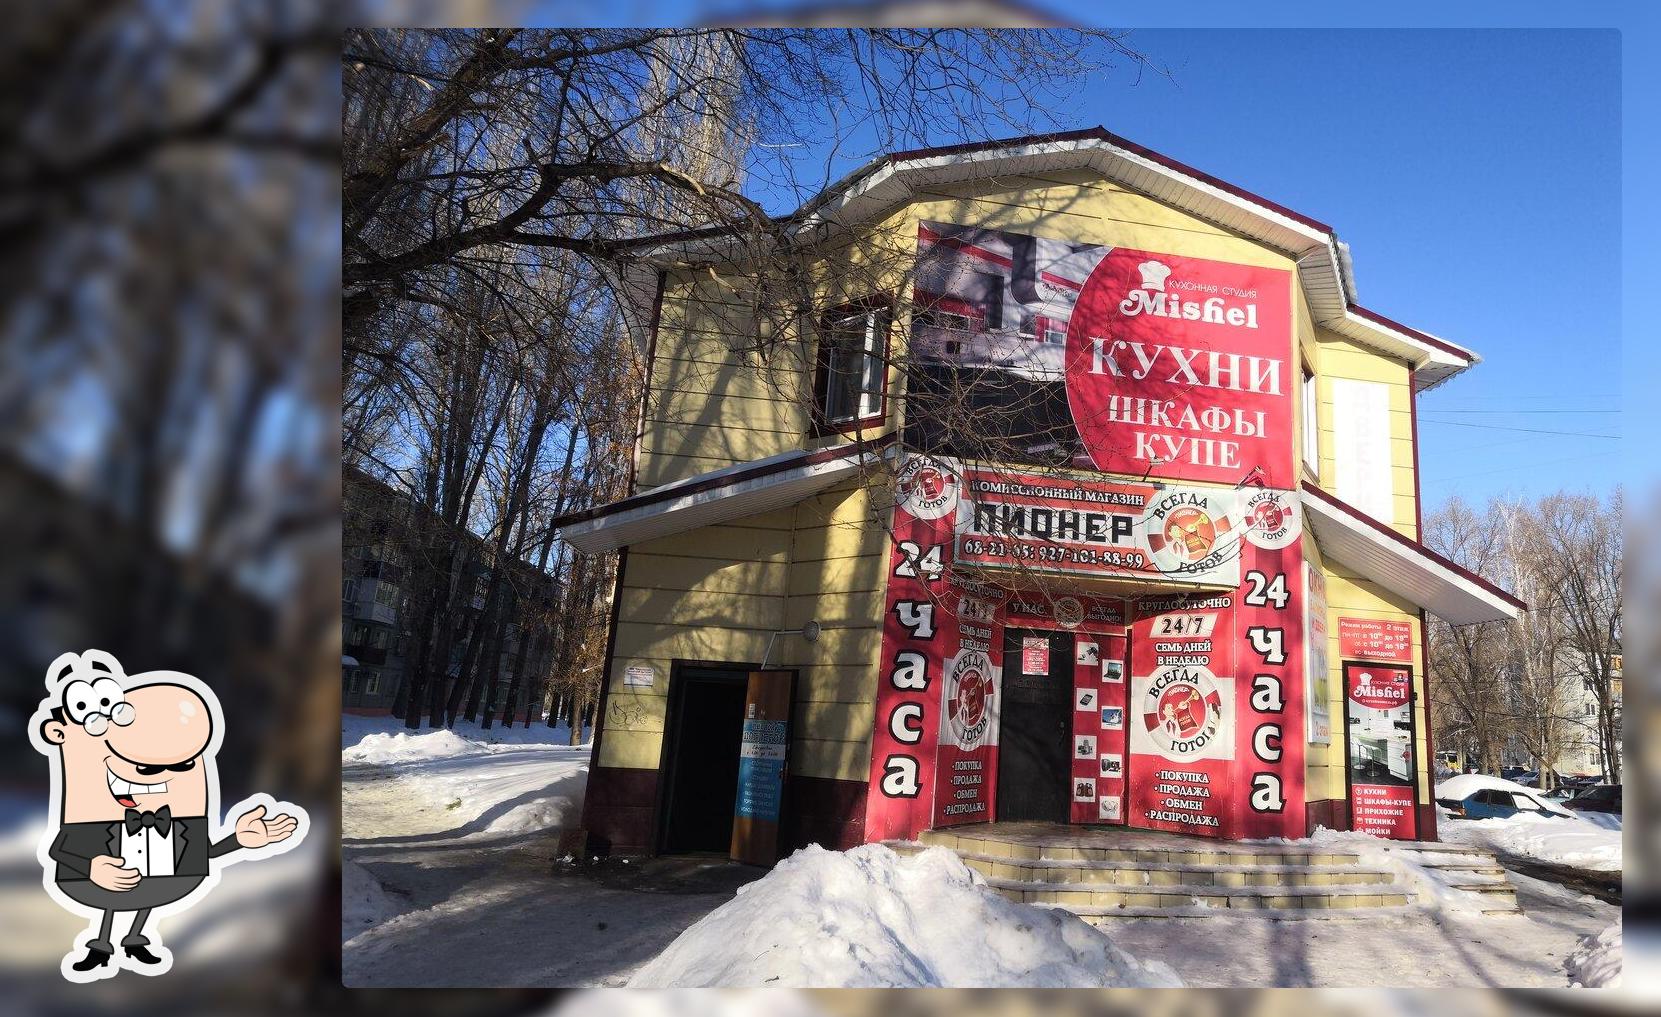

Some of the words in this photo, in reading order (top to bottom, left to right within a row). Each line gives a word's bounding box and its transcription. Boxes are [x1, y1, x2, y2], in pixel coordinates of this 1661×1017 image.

[1168, 279, 1218, 294] КУХОННАЯ
[1222, 286, 1258, 299] СТУДИЯ
[1088, 336, 1284, 397] КУХНИ
[1107, 394, 1268, 438] ШКАФЫ
[1132, 432, 1241, 469] КУПЕ
[972, 480, 1083, 501] КОМИССИОННЫЙ
[1085, 489, 1145, 506] МАГАЗИН
[1248, 493, 1280, 508] ВСЕГДА
[918, 495, 948, 509] ГОТОВ
[1153, 492, 1208, 520] ВСЕГДА
[973, 503, 1133, 543] ПИОНЕР
[1262, 526, 1288, 540] ГОТОВ
[895, 541, 943, 581] 24
[1179, 551, 1224, 574] ГОТОВ
[1245, 570, 1291, 609] 24
[1137, 597, 1231, 612] КРУГЛОСУТОЧНО
[1161, 616, 1205, 635] 24/7
[1155, 642, 1183, 653] СЕМЬ
[1182, 640, 1212, 653] ДНЕЙ
[1157, 655, 1166, 666] В
[1165, 654, 1210, 667] НЕДЕЛЮ
[952, 653, 984, 684] ВСЕГДА
[1149, 669, 1199, 699] ВСЕГДА
[881, 600, 937, 798] часа
[1246, 626, 1290, 813] часа
[962, 717, 987, 741] ГОТОВ
[954, 761, 982, 770] ПОКУПКА
[953, 775, 982, 785] ПРОДАЖА
[1159, 771, 1210, 784] ПОКУПКА
[956, 789, 978, 799] ОБМЕН
[1159, 784, 1210, 798] ПРОДАЖА
[1364, 788, 1387, 796] КУХНИ
[946, 803, 985, 815] РАСПРОДАЖА
[1165, 798, 1203, 811] ОБМЕН
[1364, 798, 1412, 807] ШКАФЫ-КУПЕ
[1150, 809, 1220, 826] РАСПРОДАЖА
[1364, 808, 1404, 816] ПРИХОЖИЕ
[1365, 818, 1397, 826] ТЕХНИКА
[1365, 827, 1391, 835] МОЙКИ
